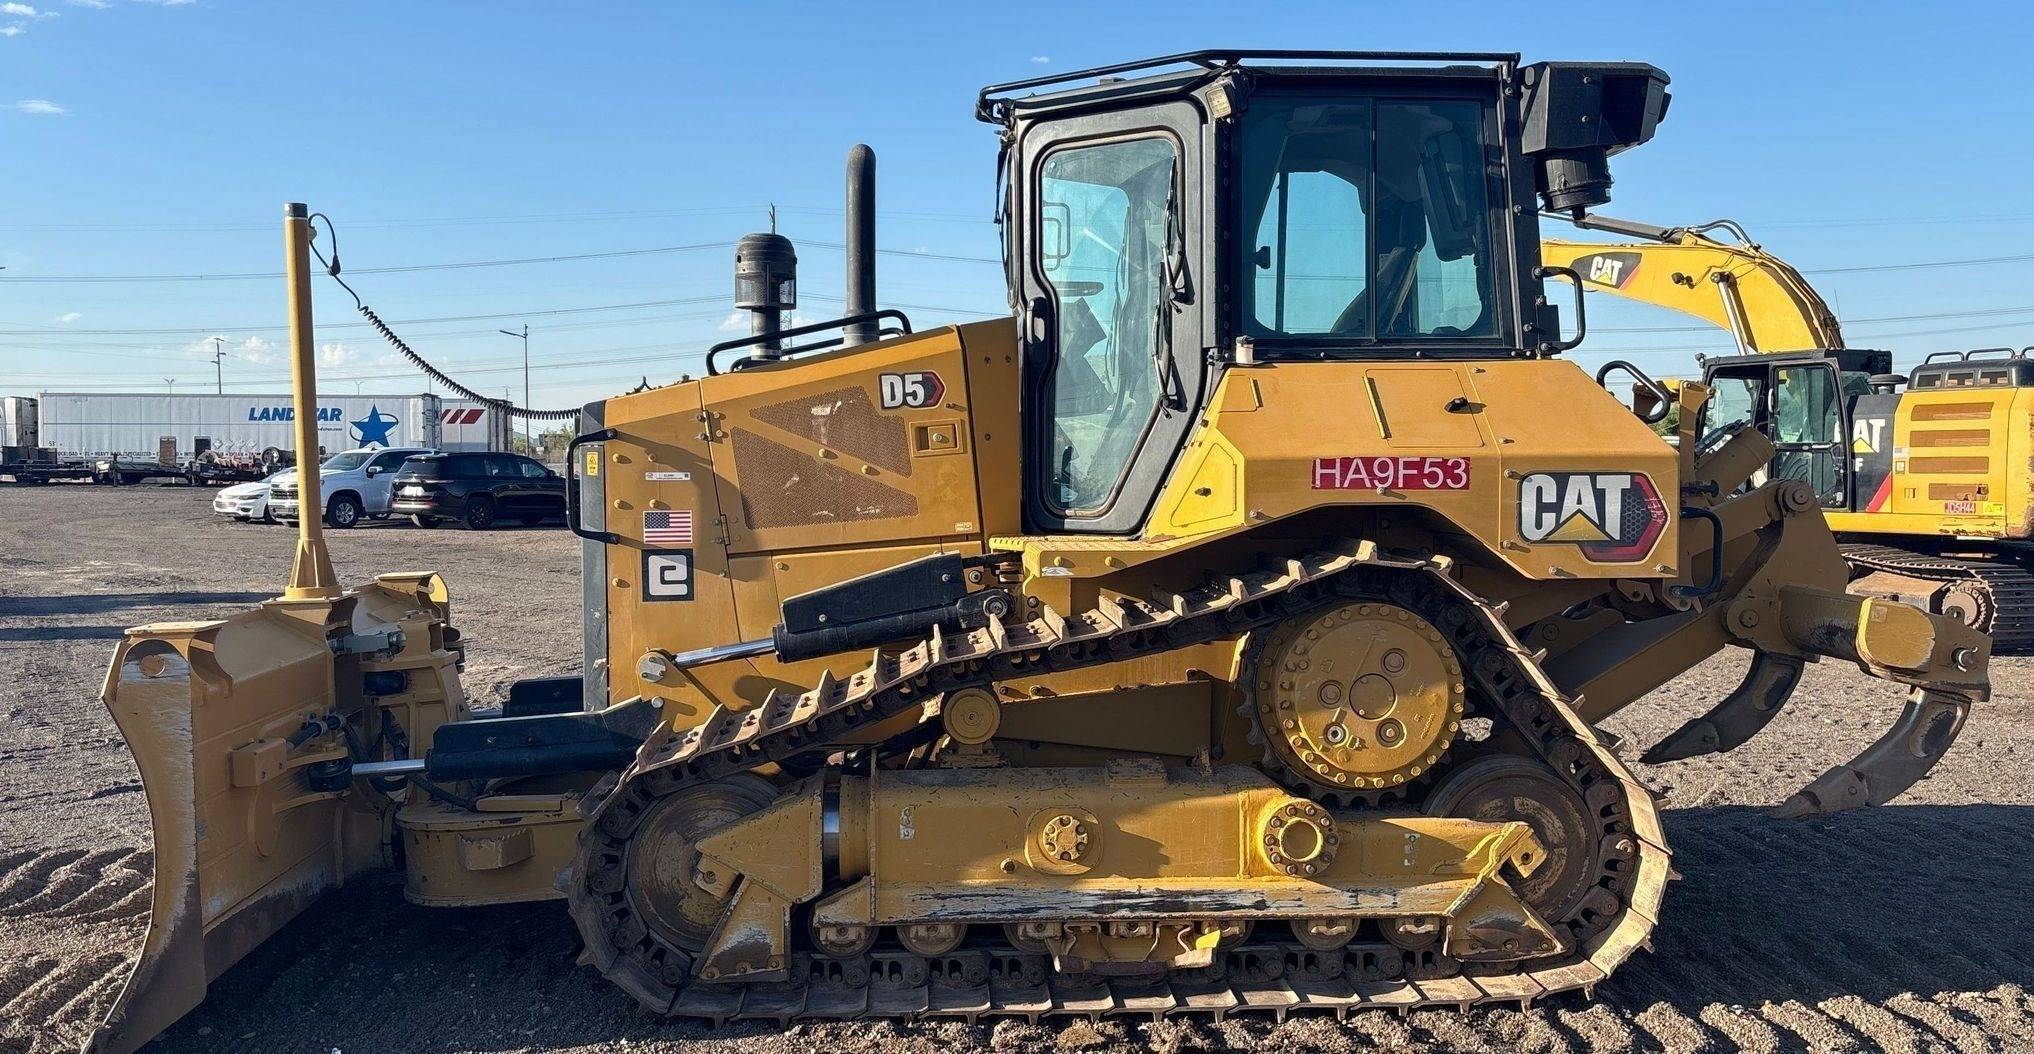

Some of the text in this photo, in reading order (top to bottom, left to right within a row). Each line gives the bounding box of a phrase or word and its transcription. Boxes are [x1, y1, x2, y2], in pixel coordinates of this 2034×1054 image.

[1590, 256, 1623, 286] CAT
[881, 374, 925, 408] D5
[248, 407, 342, 422] LANDAR
[1315, 457, 1468, 489] HA9F53
[1520, 474, 1631, 541] CAT
